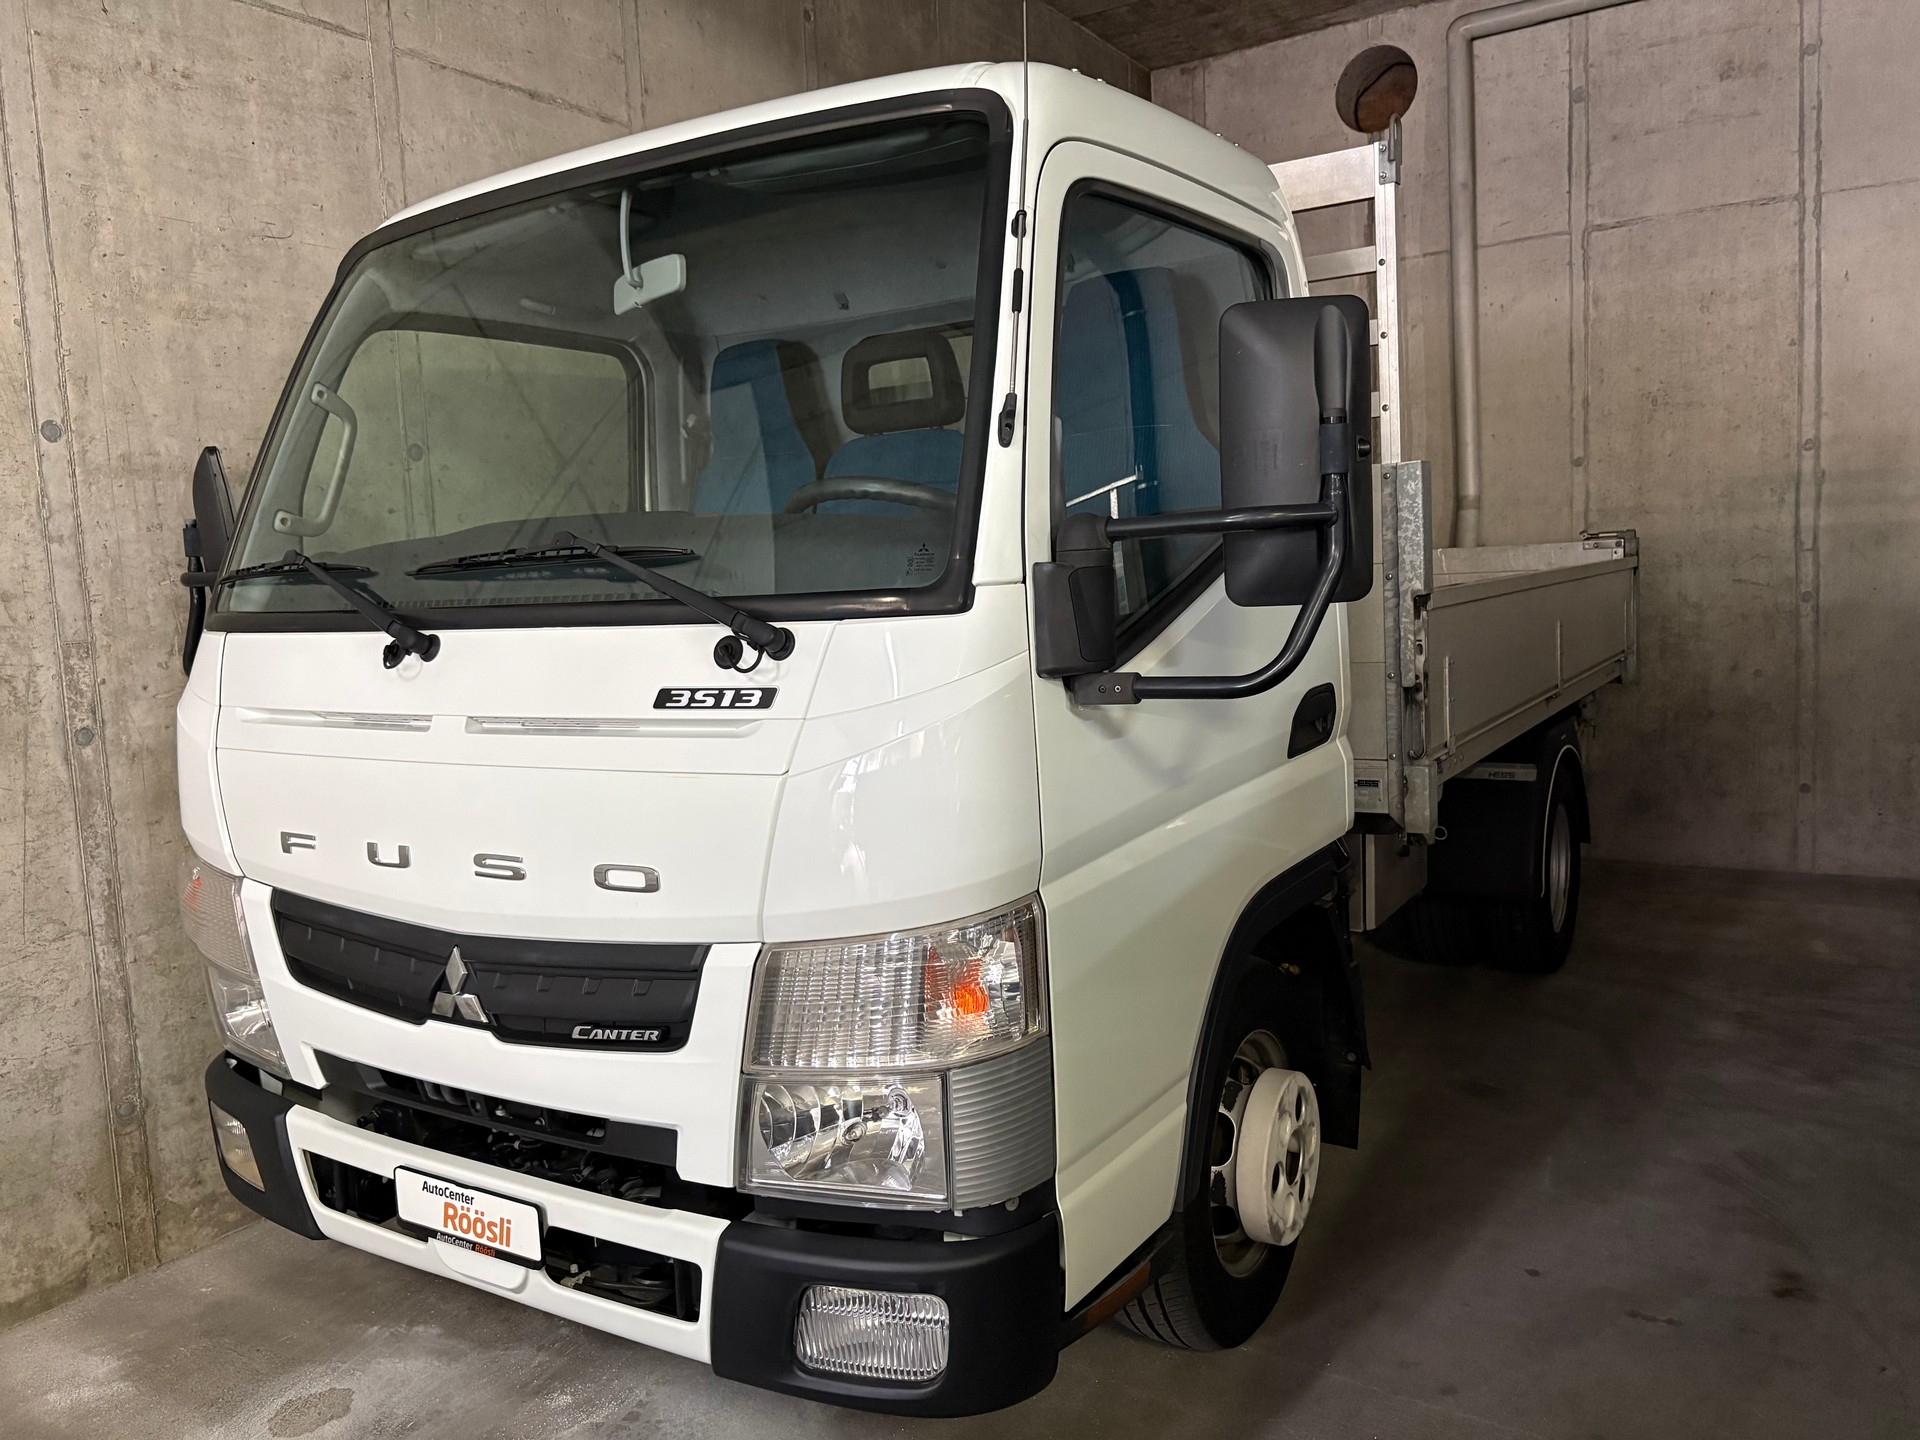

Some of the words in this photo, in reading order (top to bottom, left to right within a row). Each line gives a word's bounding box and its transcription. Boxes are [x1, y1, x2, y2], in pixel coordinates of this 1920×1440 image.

[281, 831, 661, 893] FUSO
[571, 1025, 660, 1041] CANTER
[422, 1180, 475, 1206] AutoCenter
[443, 1201, 512, 1248] Röösli
[436, 1232, 473, 1251] AutoCenter
[475, 1243, 496, 1257] Röösli
